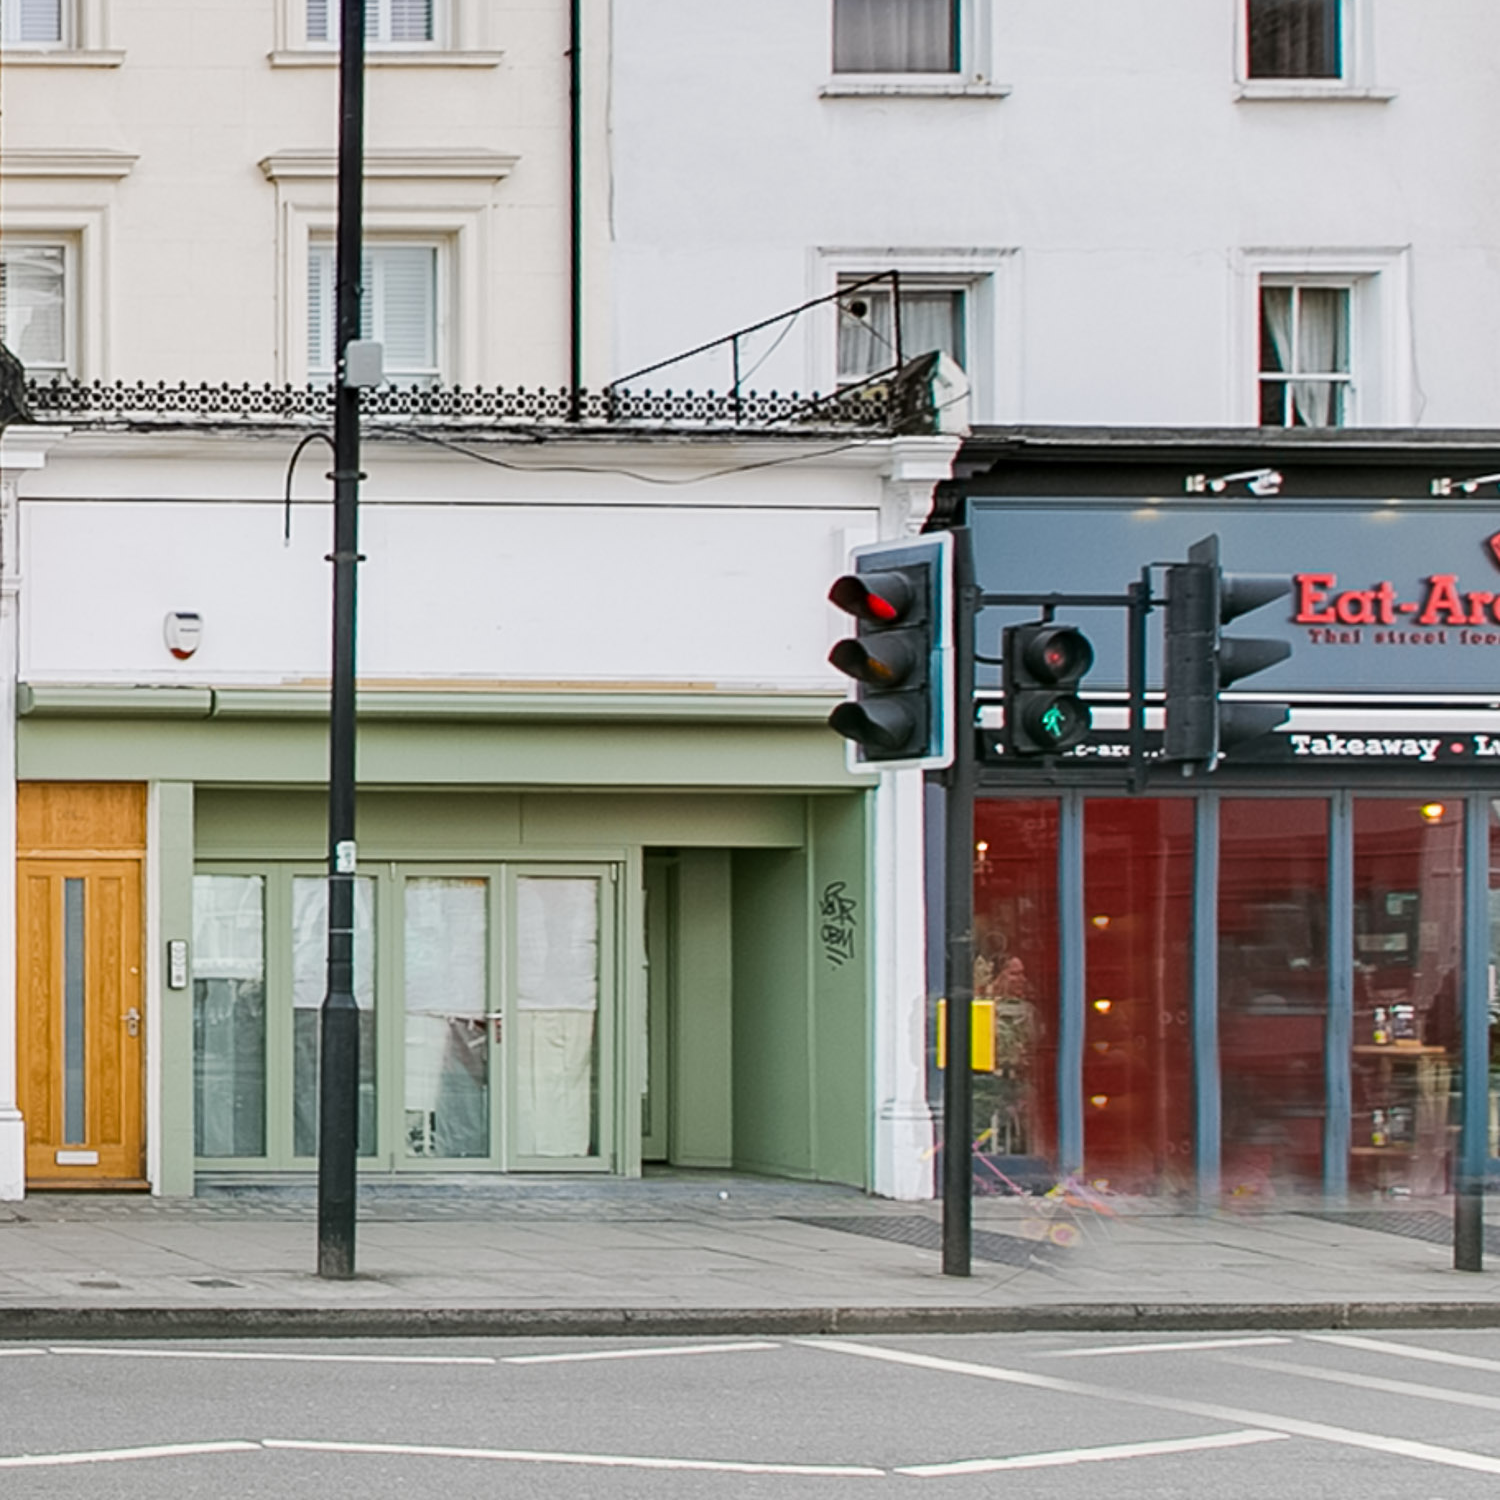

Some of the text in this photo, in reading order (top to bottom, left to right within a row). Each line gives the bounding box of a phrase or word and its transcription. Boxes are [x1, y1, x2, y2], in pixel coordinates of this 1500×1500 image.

[1308, 629, 1500, 645] Thai street foo
[1291, 733, 1441, 762] Takeaway
